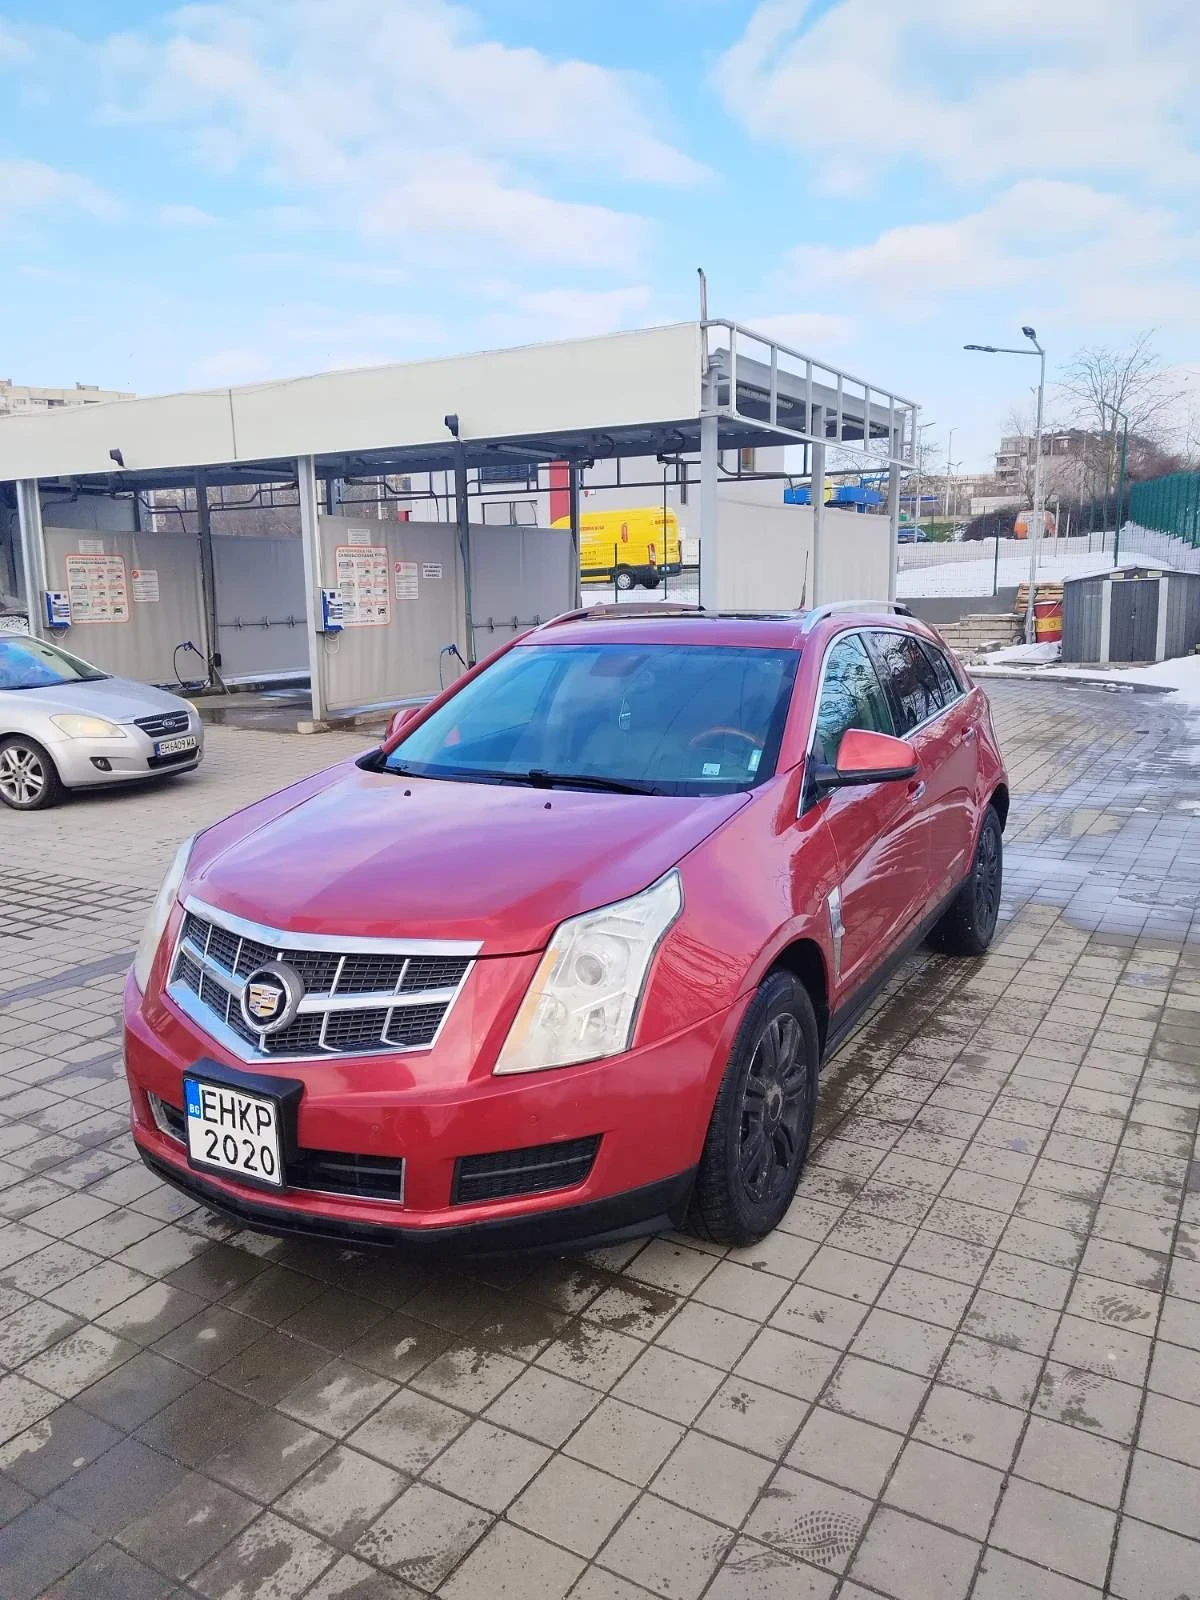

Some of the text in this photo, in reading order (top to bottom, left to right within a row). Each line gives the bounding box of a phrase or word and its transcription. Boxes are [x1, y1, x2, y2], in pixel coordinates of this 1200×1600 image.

[189, 1103, 200, 1115] BG
[201, 1089, 272, 1137] EHKP
[204, 1128, 275, 1176] 2020
